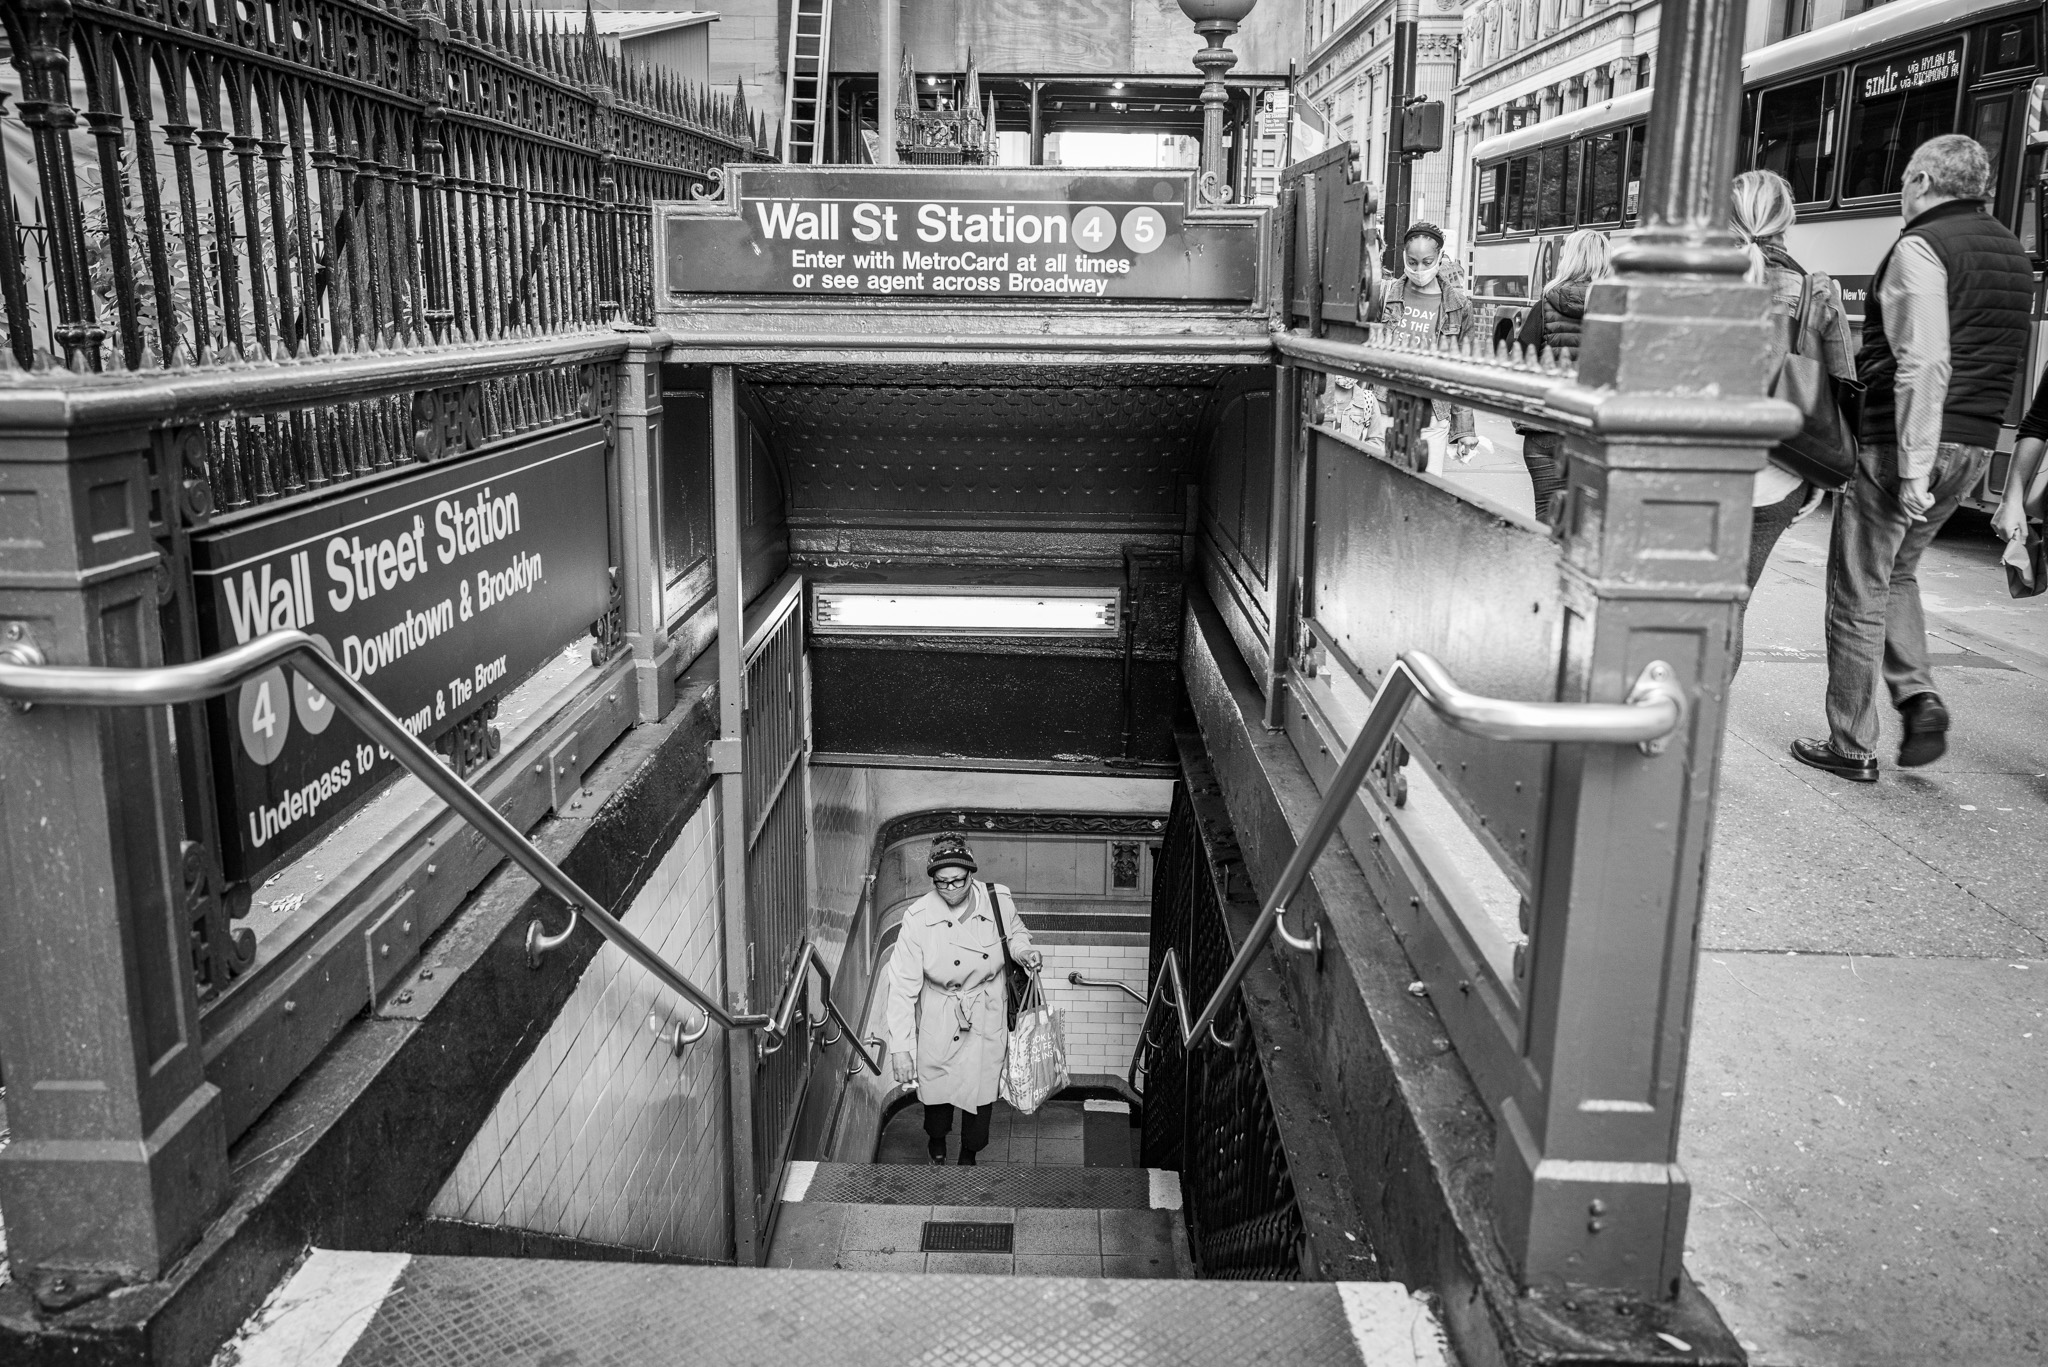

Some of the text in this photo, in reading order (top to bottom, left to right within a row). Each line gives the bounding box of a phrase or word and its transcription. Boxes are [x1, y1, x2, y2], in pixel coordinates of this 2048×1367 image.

[1907, 49, 1957, 74] via HYLAN BL
[1865, 65, 1899, 97] SIM1C
[1900, 75, 1911, 89] via
[1913, 65, 1949, 86] RICHMOND
[756, 202, 1154, 245] Wall St Station 4 5
[792, 250, 1131, 275] Enter with MetroCard at all times
[792, 273, 1109, 297] or see agent across Broadway
[1843, 288, 1868, 301] New Yo
[1404, 306, 1436, 320] ODAY
[1410, 321, 1430, 333] THE
[223, 487, 521, 645] Wall Street Station
[342, 551, 542, 682] Downtown & Brooklyn
[251, 681, 276, 738] 4
[249, 762, 352, 849] Underpass
[356, 743, 374, 775] to
[435, 690, 446, 718] &
[449, 673, 473, 707] The
[475, 653, 508, 692] Bronx
